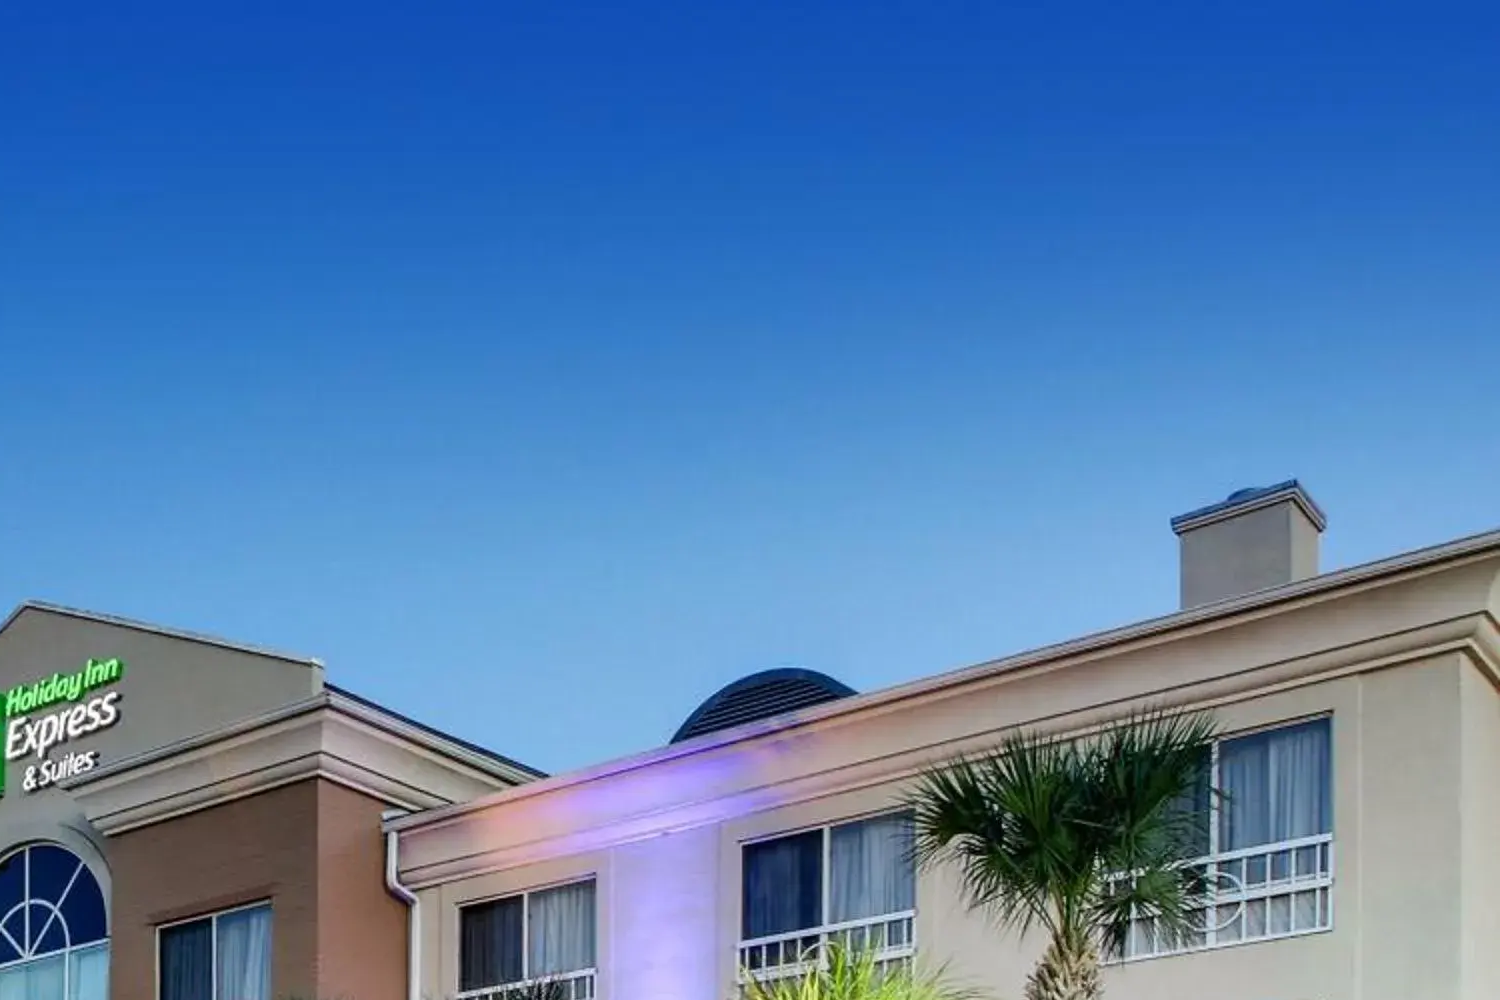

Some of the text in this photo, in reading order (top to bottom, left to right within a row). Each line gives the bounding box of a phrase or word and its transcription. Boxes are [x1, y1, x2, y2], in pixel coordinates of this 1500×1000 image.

[6, 658, 118, 716] Holiday Inn
[5, 691, 117, 759] Express
[22, 751, 95, 791] & Suites
